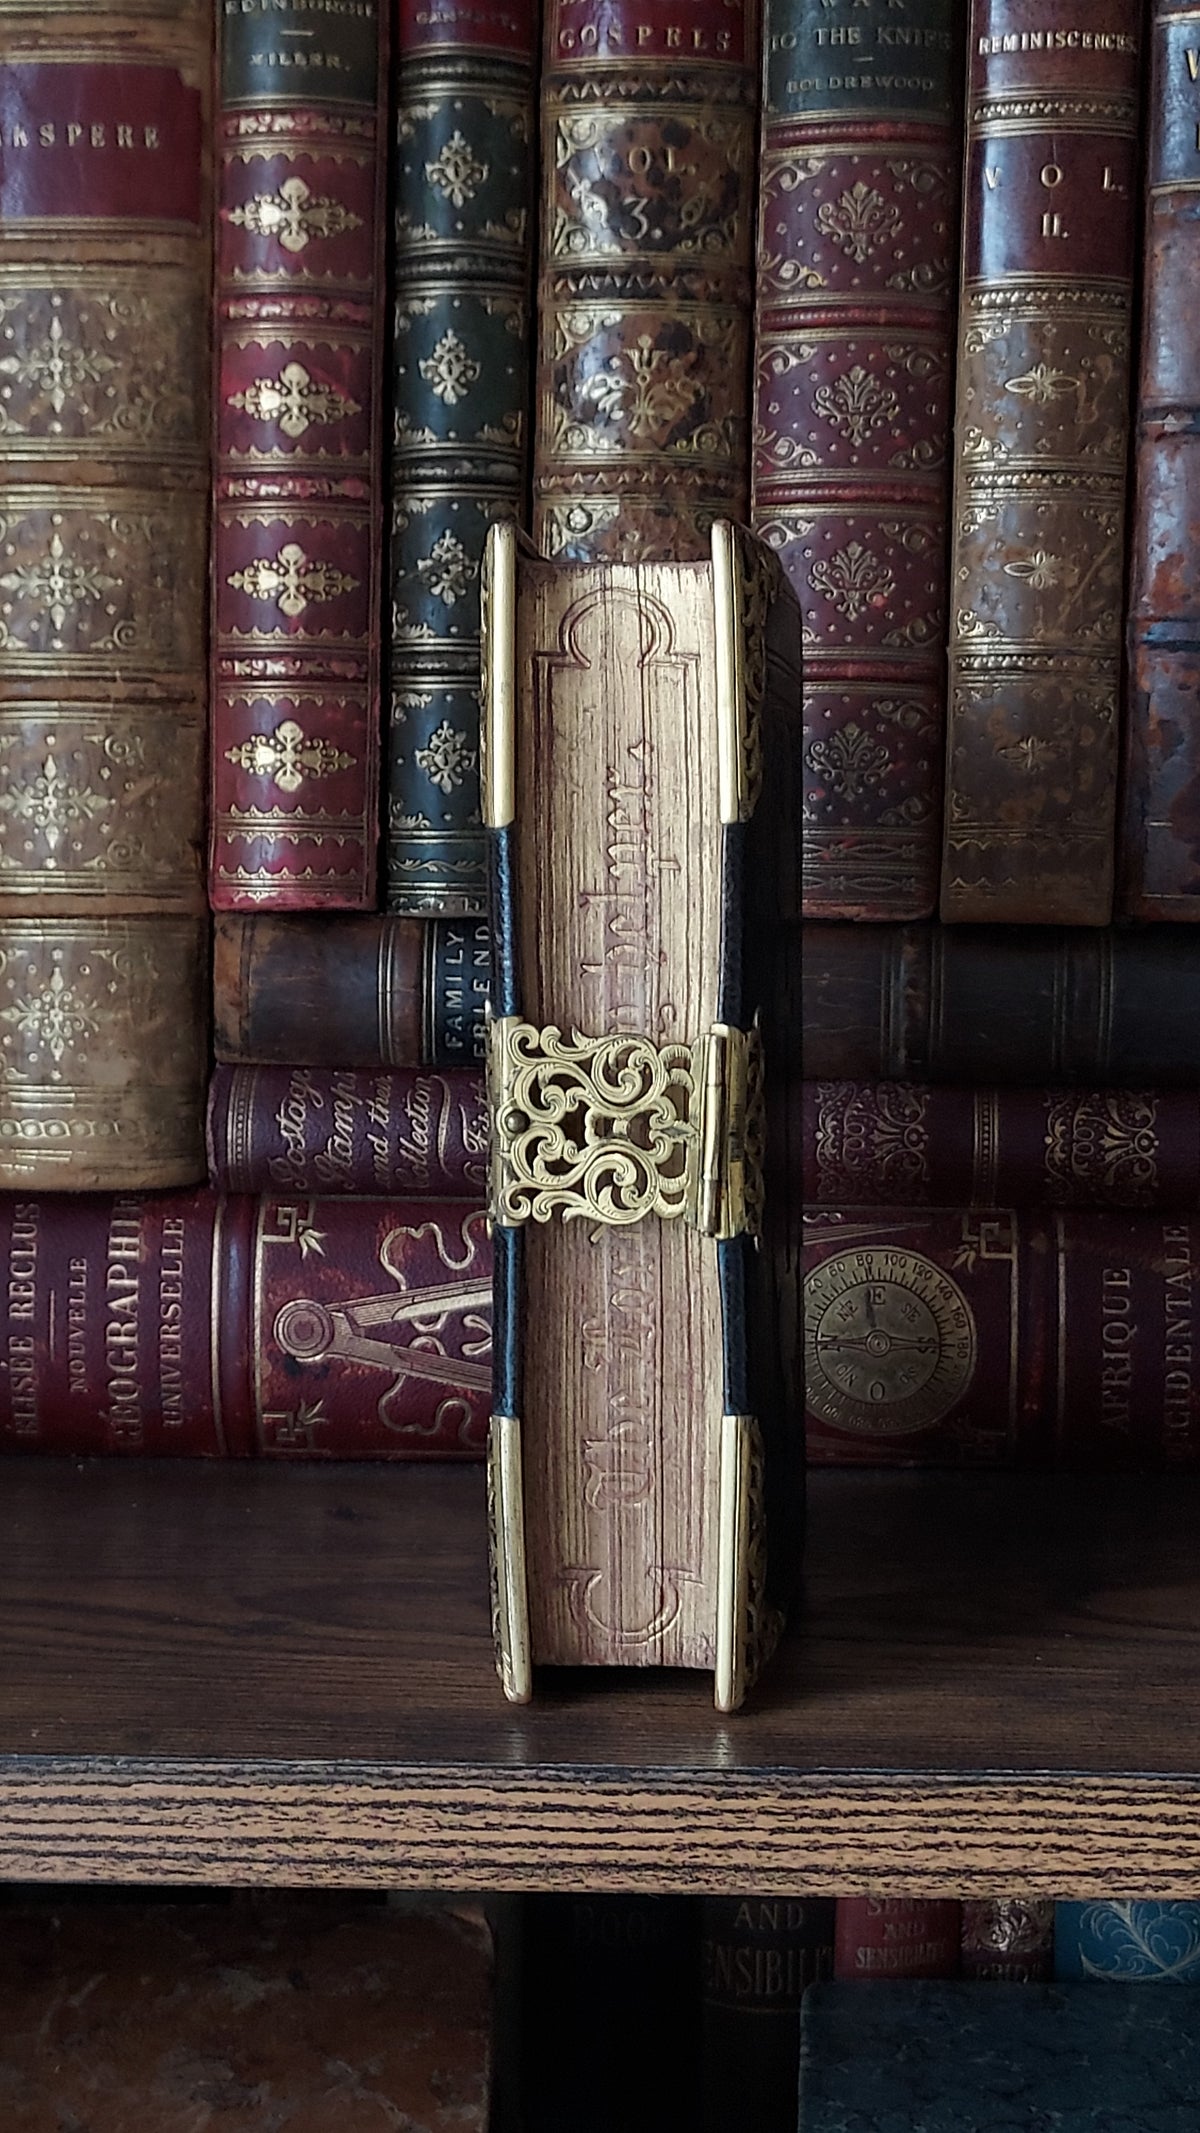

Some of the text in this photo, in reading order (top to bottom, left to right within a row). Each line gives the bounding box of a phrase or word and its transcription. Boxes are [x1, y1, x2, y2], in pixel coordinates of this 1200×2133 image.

[559, 25, 732, 50] GOSPELS
[813, 27, 861, 46] THE
[787, 75, 934, 94] BOLDREWOOD
[0, 122, 160, 149] KSPERE
[444, 930, 464, 1050] FAMILY
[473, 924, 491, 1059] FRIEND
[267, 1069, 324, 1190] Postage
[313, 1070, 363, 1190] Stamps
[366, 1132, 392, 1190] and
[8, 1201, 40, 1320] RECLUS
[884, 1253, 908, 1269] 100
[911, 1262, 934, 1282] 120
[870, 1286, 886, 1305] E
[936, 1279, 953, 1301] 140
[68, 1257, 88, 1393] NOUVELLE
[160, 1217, 185, 1428] UNIVERSELLE
[950, 1306, 967, 1329] 160
[956, 1336, 969, 1360] 180
[1101, 1267, 1137, 1434] AFRIQUE
[735, 1902, 804, 1931] AND
